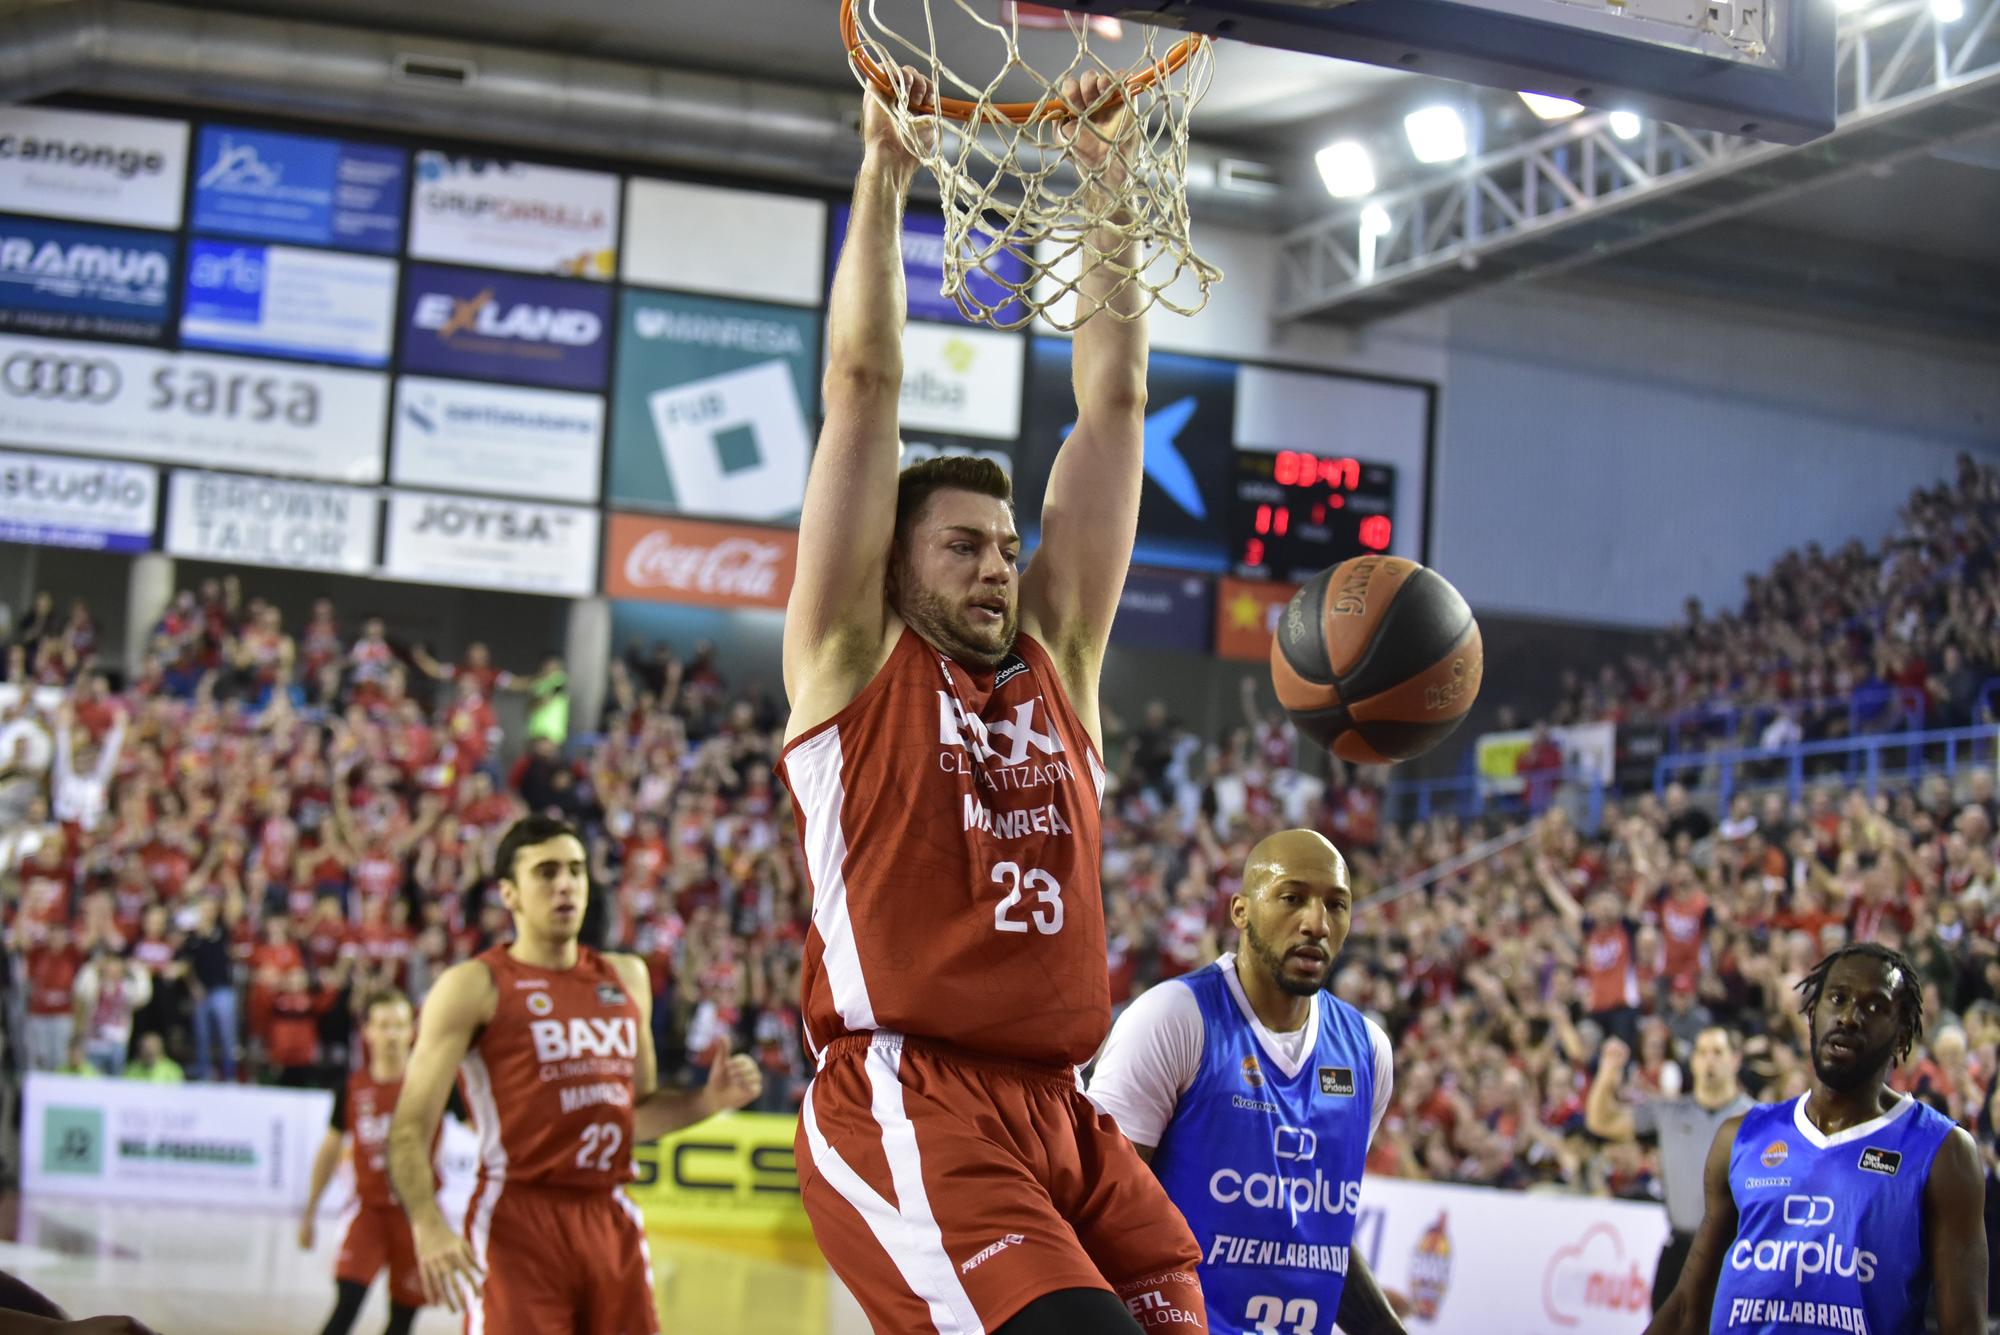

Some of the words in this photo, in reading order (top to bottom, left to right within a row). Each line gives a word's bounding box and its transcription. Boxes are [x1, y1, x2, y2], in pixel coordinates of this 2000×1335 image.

[413, 287, 603, 347] EXLAND
[150, 364, 320, 428] sarsa
[4, 462, 147, 509] studio
[192, 476, 349, 522] BROWN
[196, 518, 347, 563] TAILOR
[413, 501, 549, 542] JOYSA
[990, 860, 1065, 936] 23
[529, 1016, 638, 1064] BAXI
[575, 1123, 623, 1171] 22
[1209, 1168, 1362, 1229] carplus
[1731, 1232, 1879, 1289] carplus
[1125, 1290, 1171, 1314] ETL
[1727, 1297, 1868, 1335] FUENLABRADA
